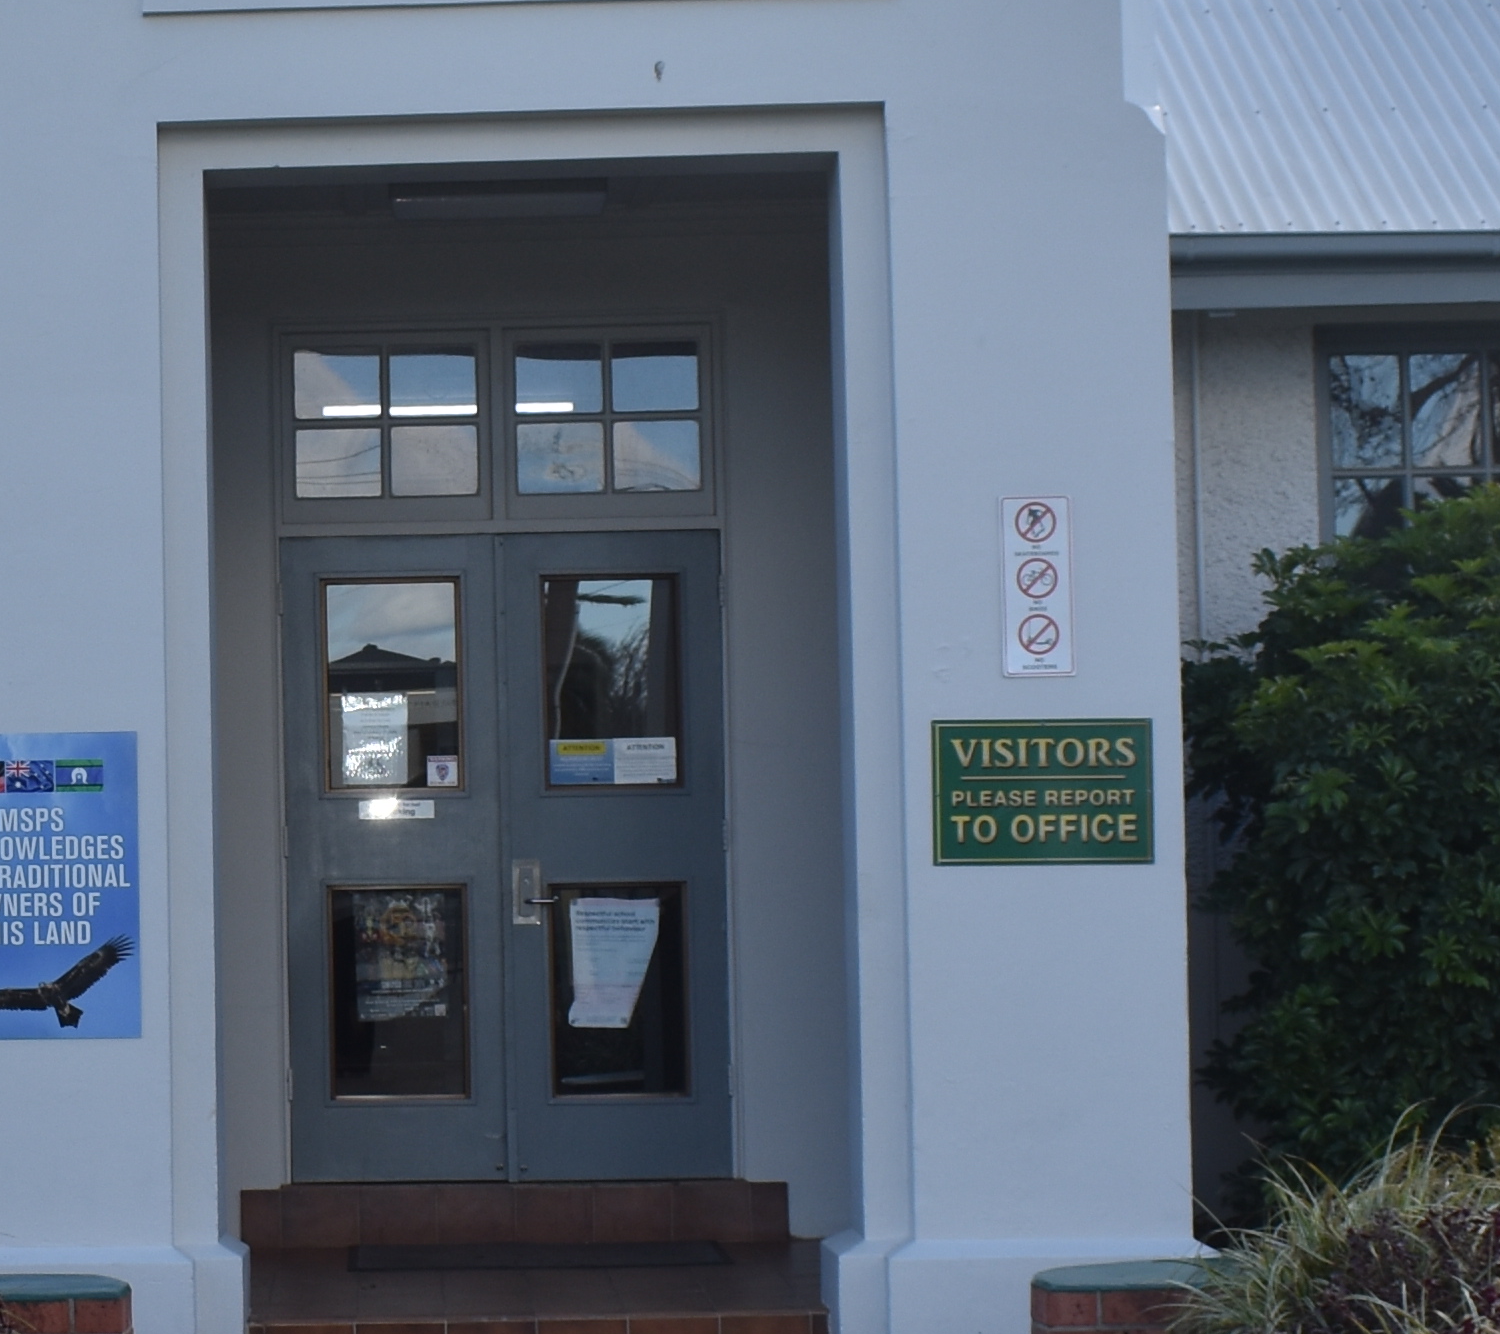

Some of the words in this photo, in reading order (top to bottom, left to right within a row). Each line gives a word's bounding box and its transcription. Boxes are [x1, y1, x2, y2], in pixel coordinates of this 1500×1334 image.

[950, 737, 1136, 768] VISITORS
[952, 790, 1037, 807] PLEASE
[1045, 789, 1135, 806] REPORT
[951, 815, 998, 843] TO
[1010, 814, 1138, 843] OFFICE
[72, 892, 101, 916] OF
[34, 920, 91, 945] LAND
